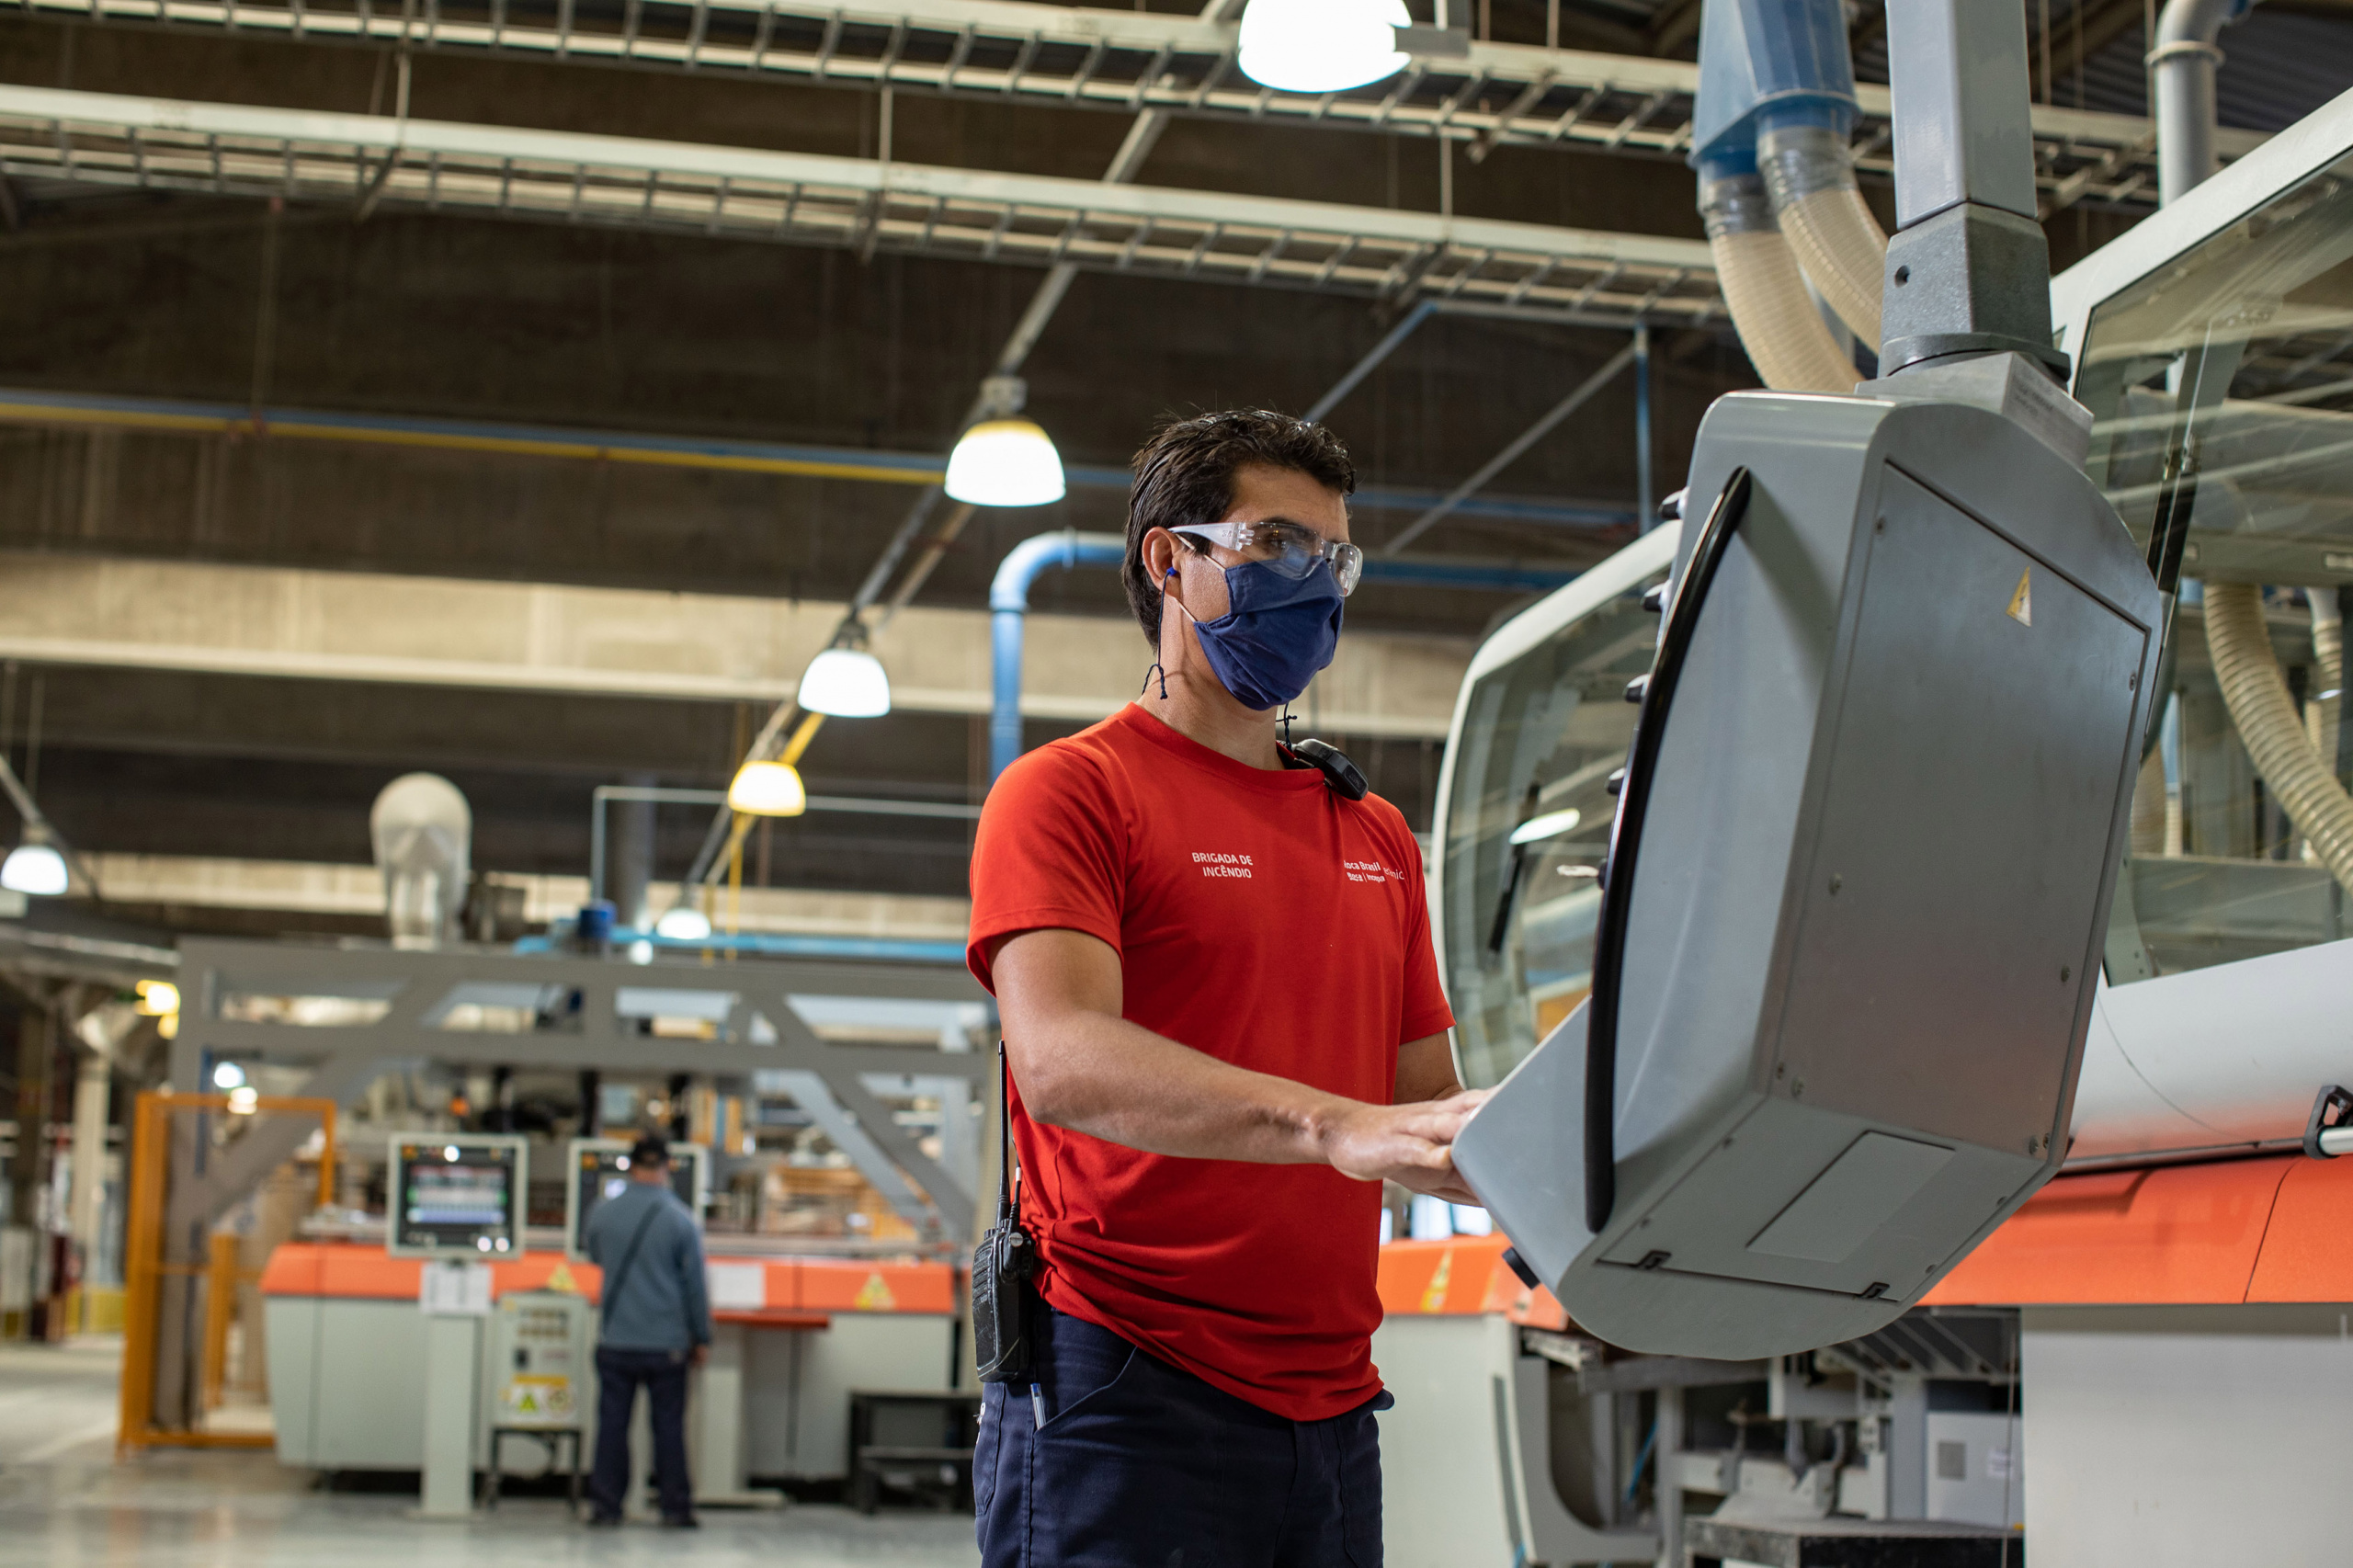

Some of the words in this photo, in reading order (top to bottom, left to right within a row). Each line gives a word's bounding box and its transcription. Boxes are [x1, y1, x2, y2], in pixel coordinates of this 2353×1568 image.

[1191, 852, 1239, 864] BRIGADA
[1239, 855, 1254, 866] DE
[1202, 864, 1252, 879] INCÊNDIO
